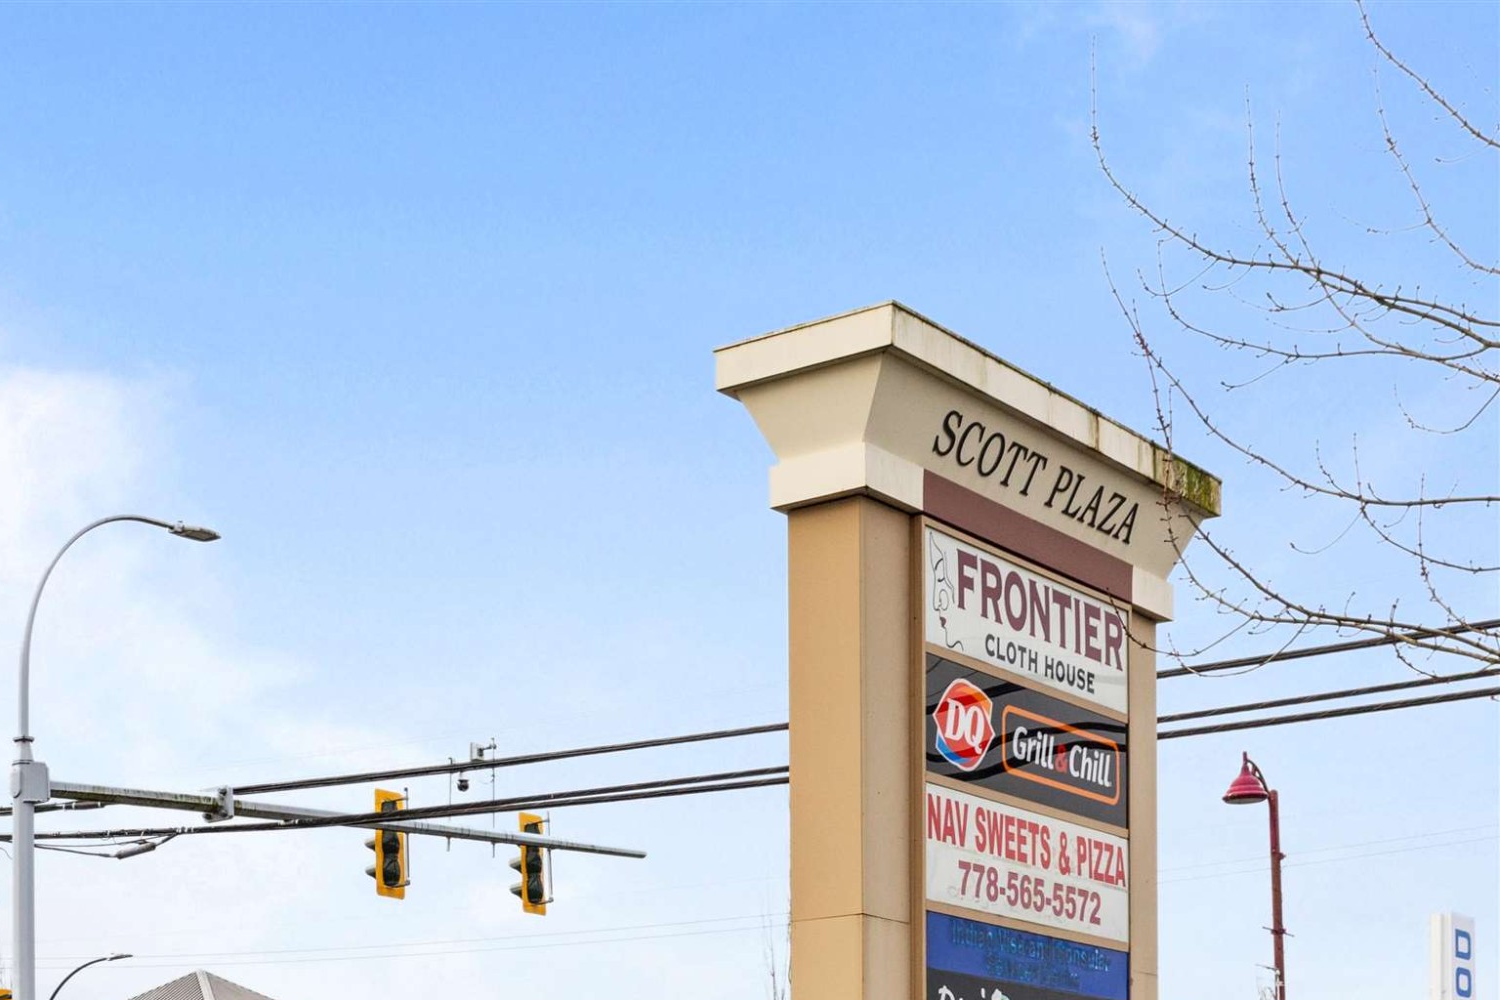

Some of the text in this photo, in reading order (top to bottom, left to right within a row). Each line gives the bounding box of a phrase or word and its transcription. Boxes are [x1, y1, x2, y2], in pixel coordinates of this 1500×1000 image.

[932, 410, 1140, 545] SCOTT PLAZA
[956, 548, 1123, 671] FRONTIER
[985, 633, 1095, 694] CLOTH HOUSE
[945, 697, 986, 754] DQ
[1012, 726, 1055, 770] Grill
[1069, 745, 1112, 787] Chill
[927, 793, 1126, 887] NAV SWEETS & PIZZA
[958, 860, 1101, 926] 778-565-5572
